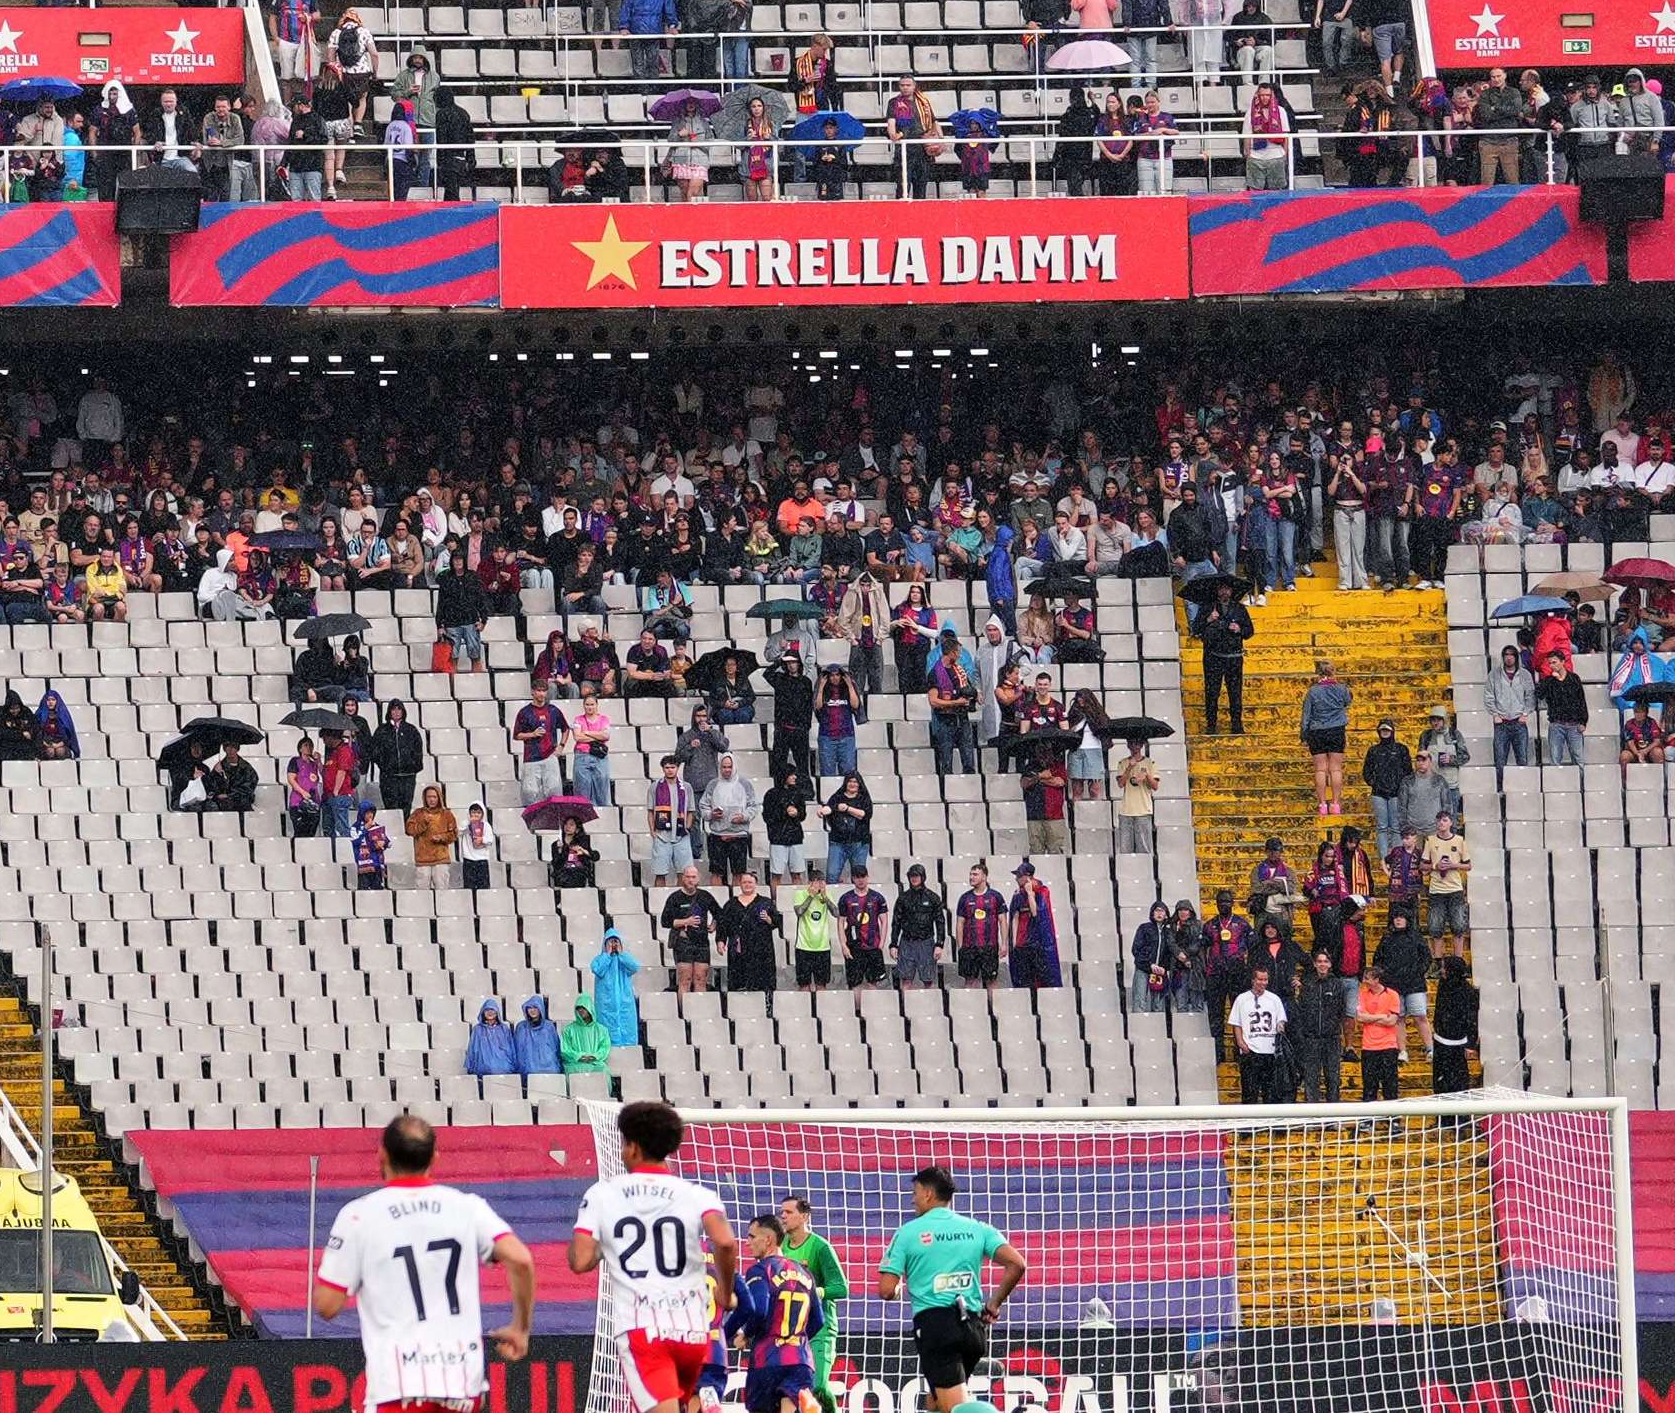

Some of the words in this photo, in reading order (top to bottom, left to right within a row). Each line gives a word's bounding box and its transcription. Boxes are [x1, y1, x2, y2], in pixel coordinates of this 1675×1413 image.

[1455, 37, 1520, 50] ESTRELLA
[1476, 49, 1500, 58] DAMM
[150, 53, 215, 66] ESTRELLA
[171, 65, 195, 73] DAMM
[660, 237, 927, 288] ESTRELLA
[941, 234, 1117, 285] DAMM
[1248, 1011, 1272, 1033] 23
[622, 1184, 675, 1200] WITSEL
[388, 1199, 442, 1220] BLIND
[613, 1215, 687, 1279] 20
[393, 1237, 463, 1322] 17
[778, 1290, 811, 1337] 17
